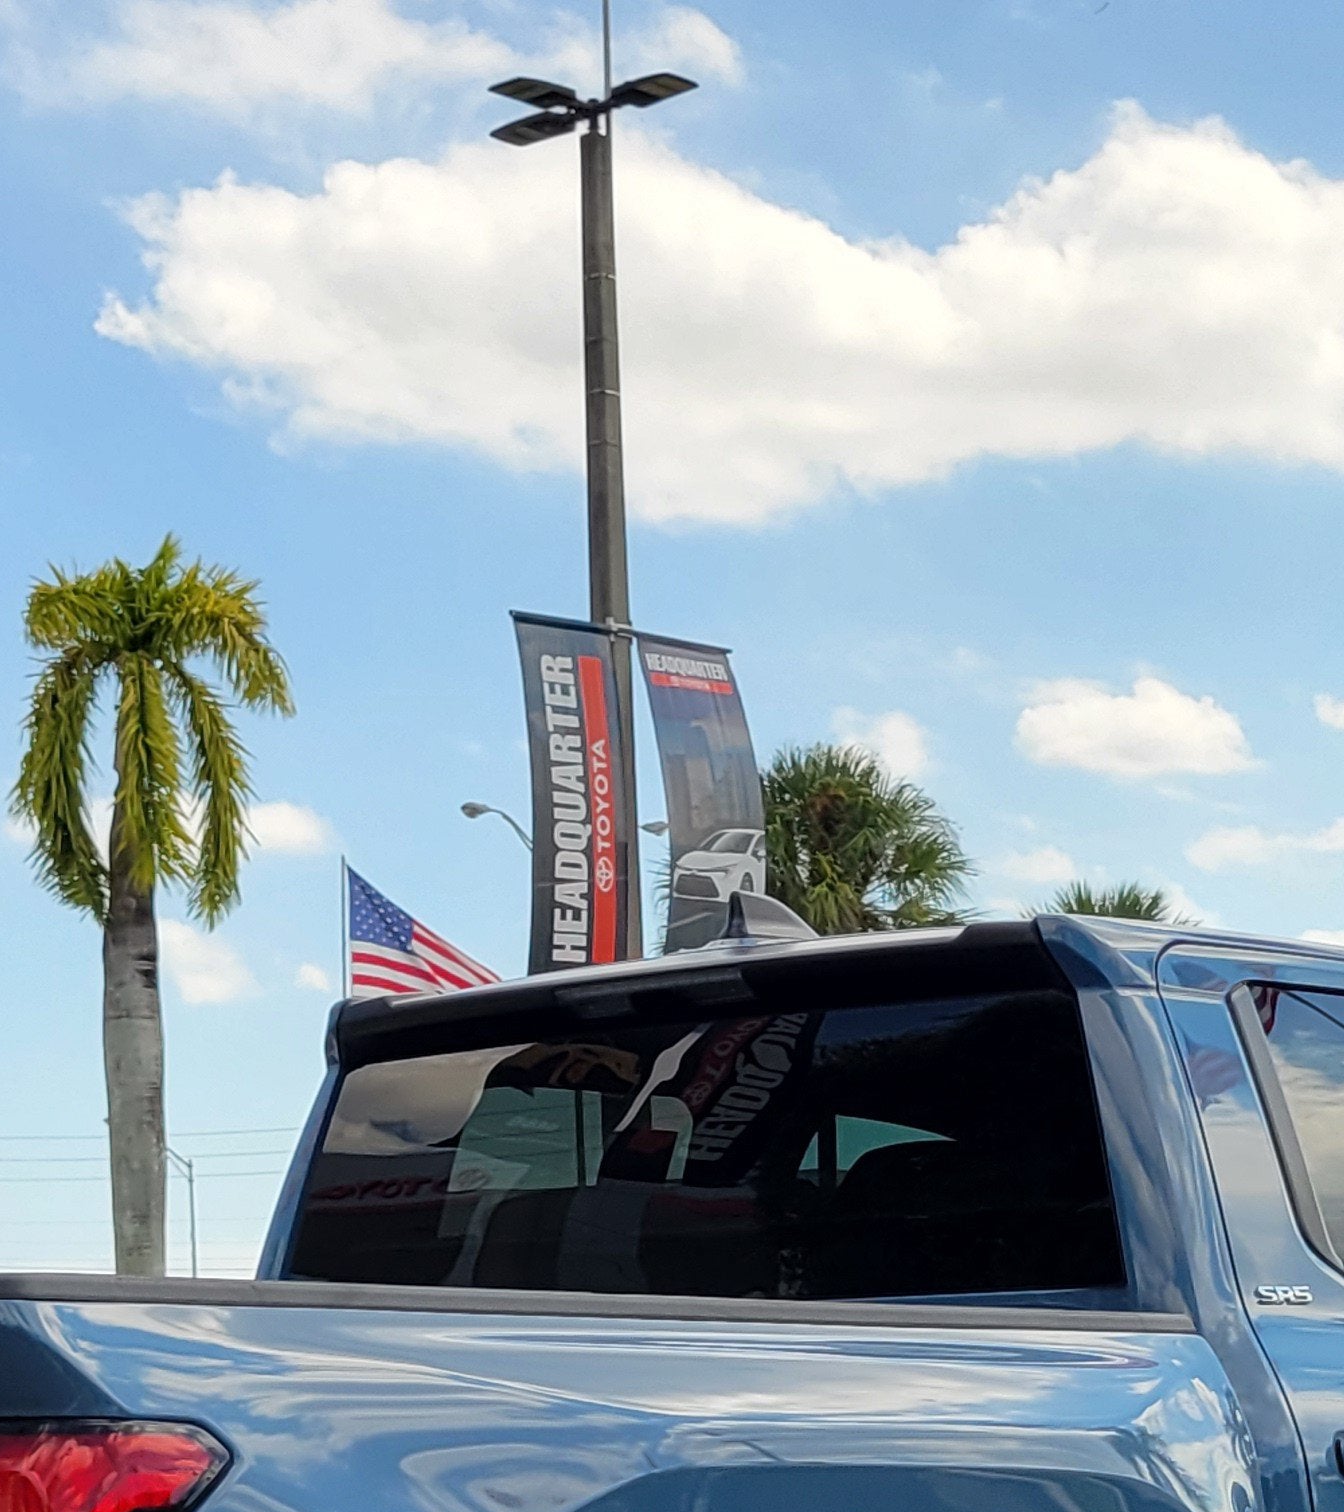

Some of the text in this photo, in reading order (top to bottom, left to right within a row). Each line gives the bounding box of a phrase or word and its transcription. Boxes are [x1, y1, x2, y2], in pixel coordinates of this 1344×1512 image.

[540, 653, 593, 964] HEADQUARTER
[592, 739, 612, 851] TOYOTA
[1256, 1286, 1313, 1304] SR5
